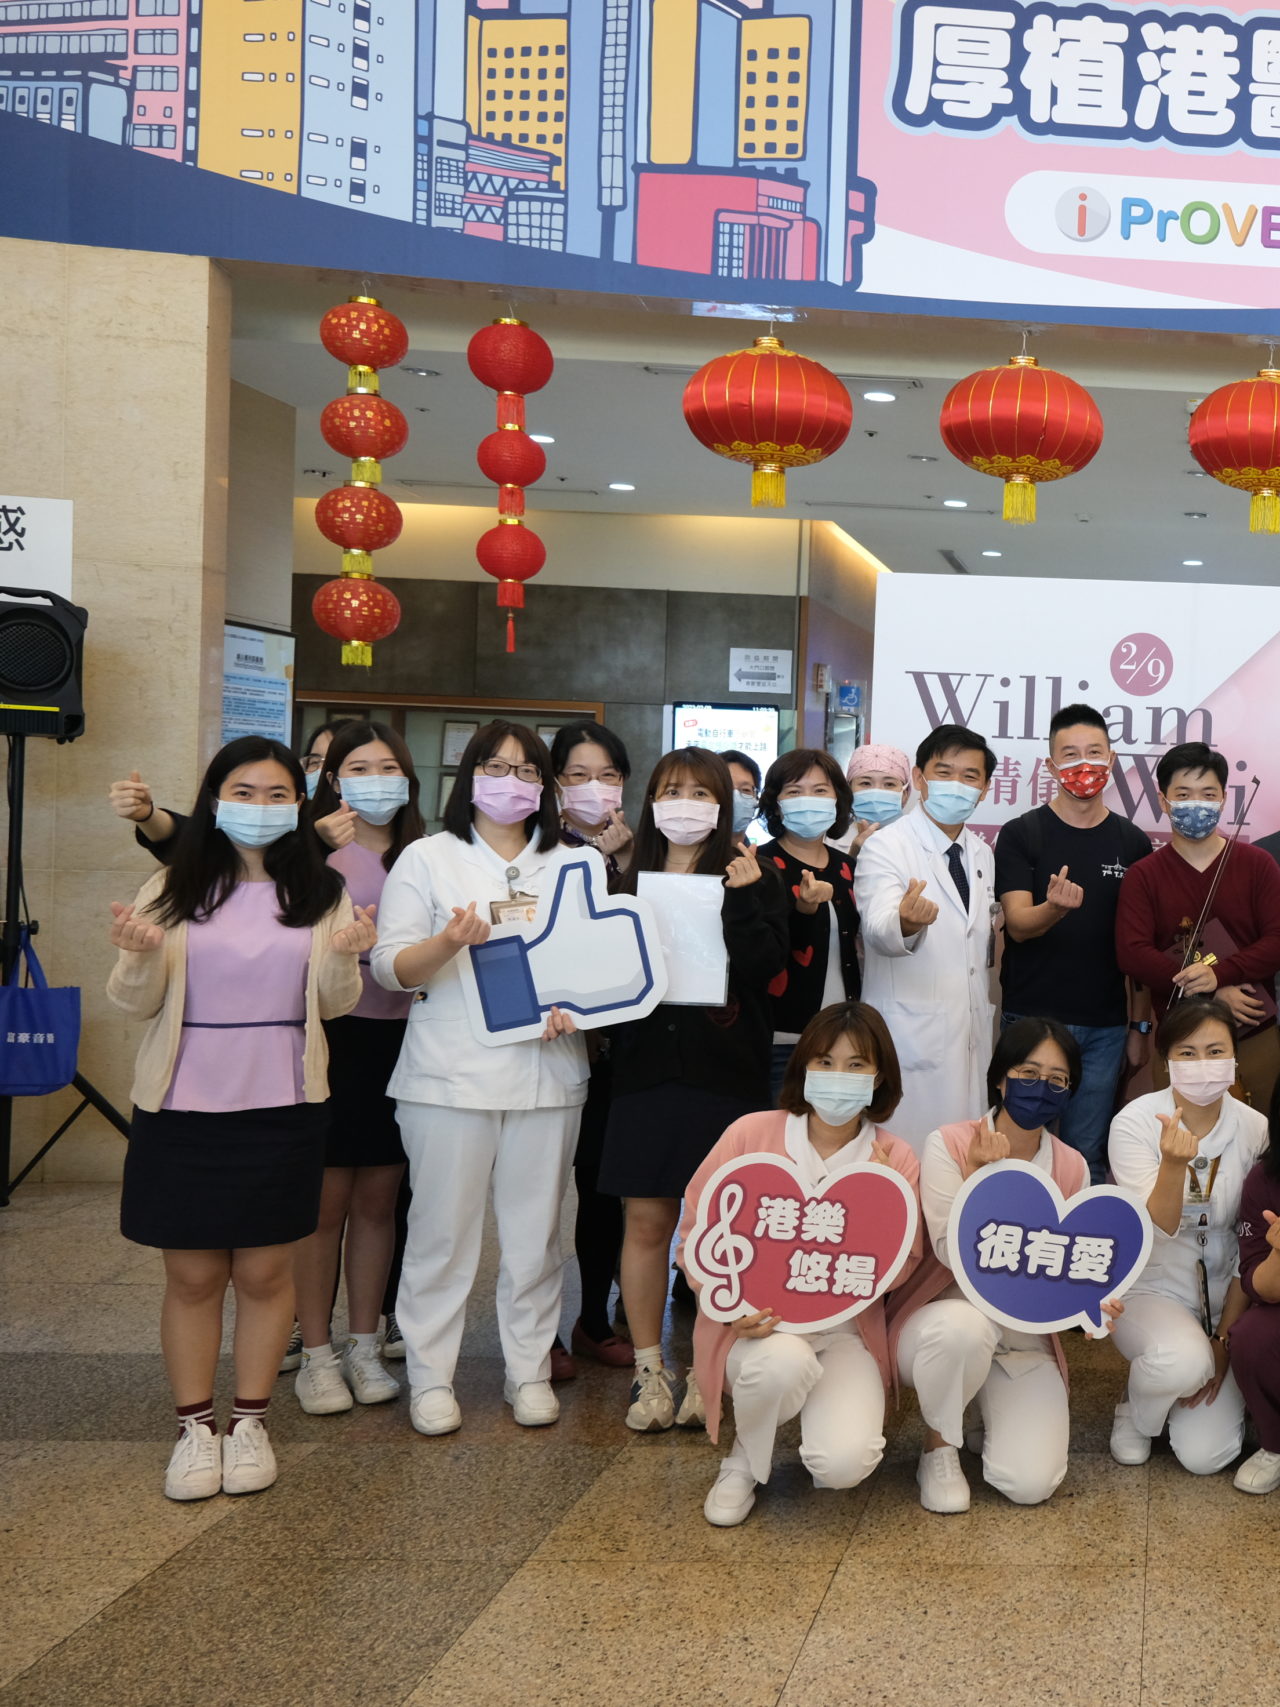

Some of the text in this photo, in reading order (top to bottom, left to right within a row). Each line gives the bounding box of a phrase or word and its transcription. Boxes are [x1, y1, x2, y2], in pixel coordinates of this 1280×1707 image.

[905, 670, 1219, 748] Willam
[753, 1196, 847, 1244] 港樂
[786, 1249, 877, 1298] 悠揚
[977, 1222, 1114, 1283] 很有愛
